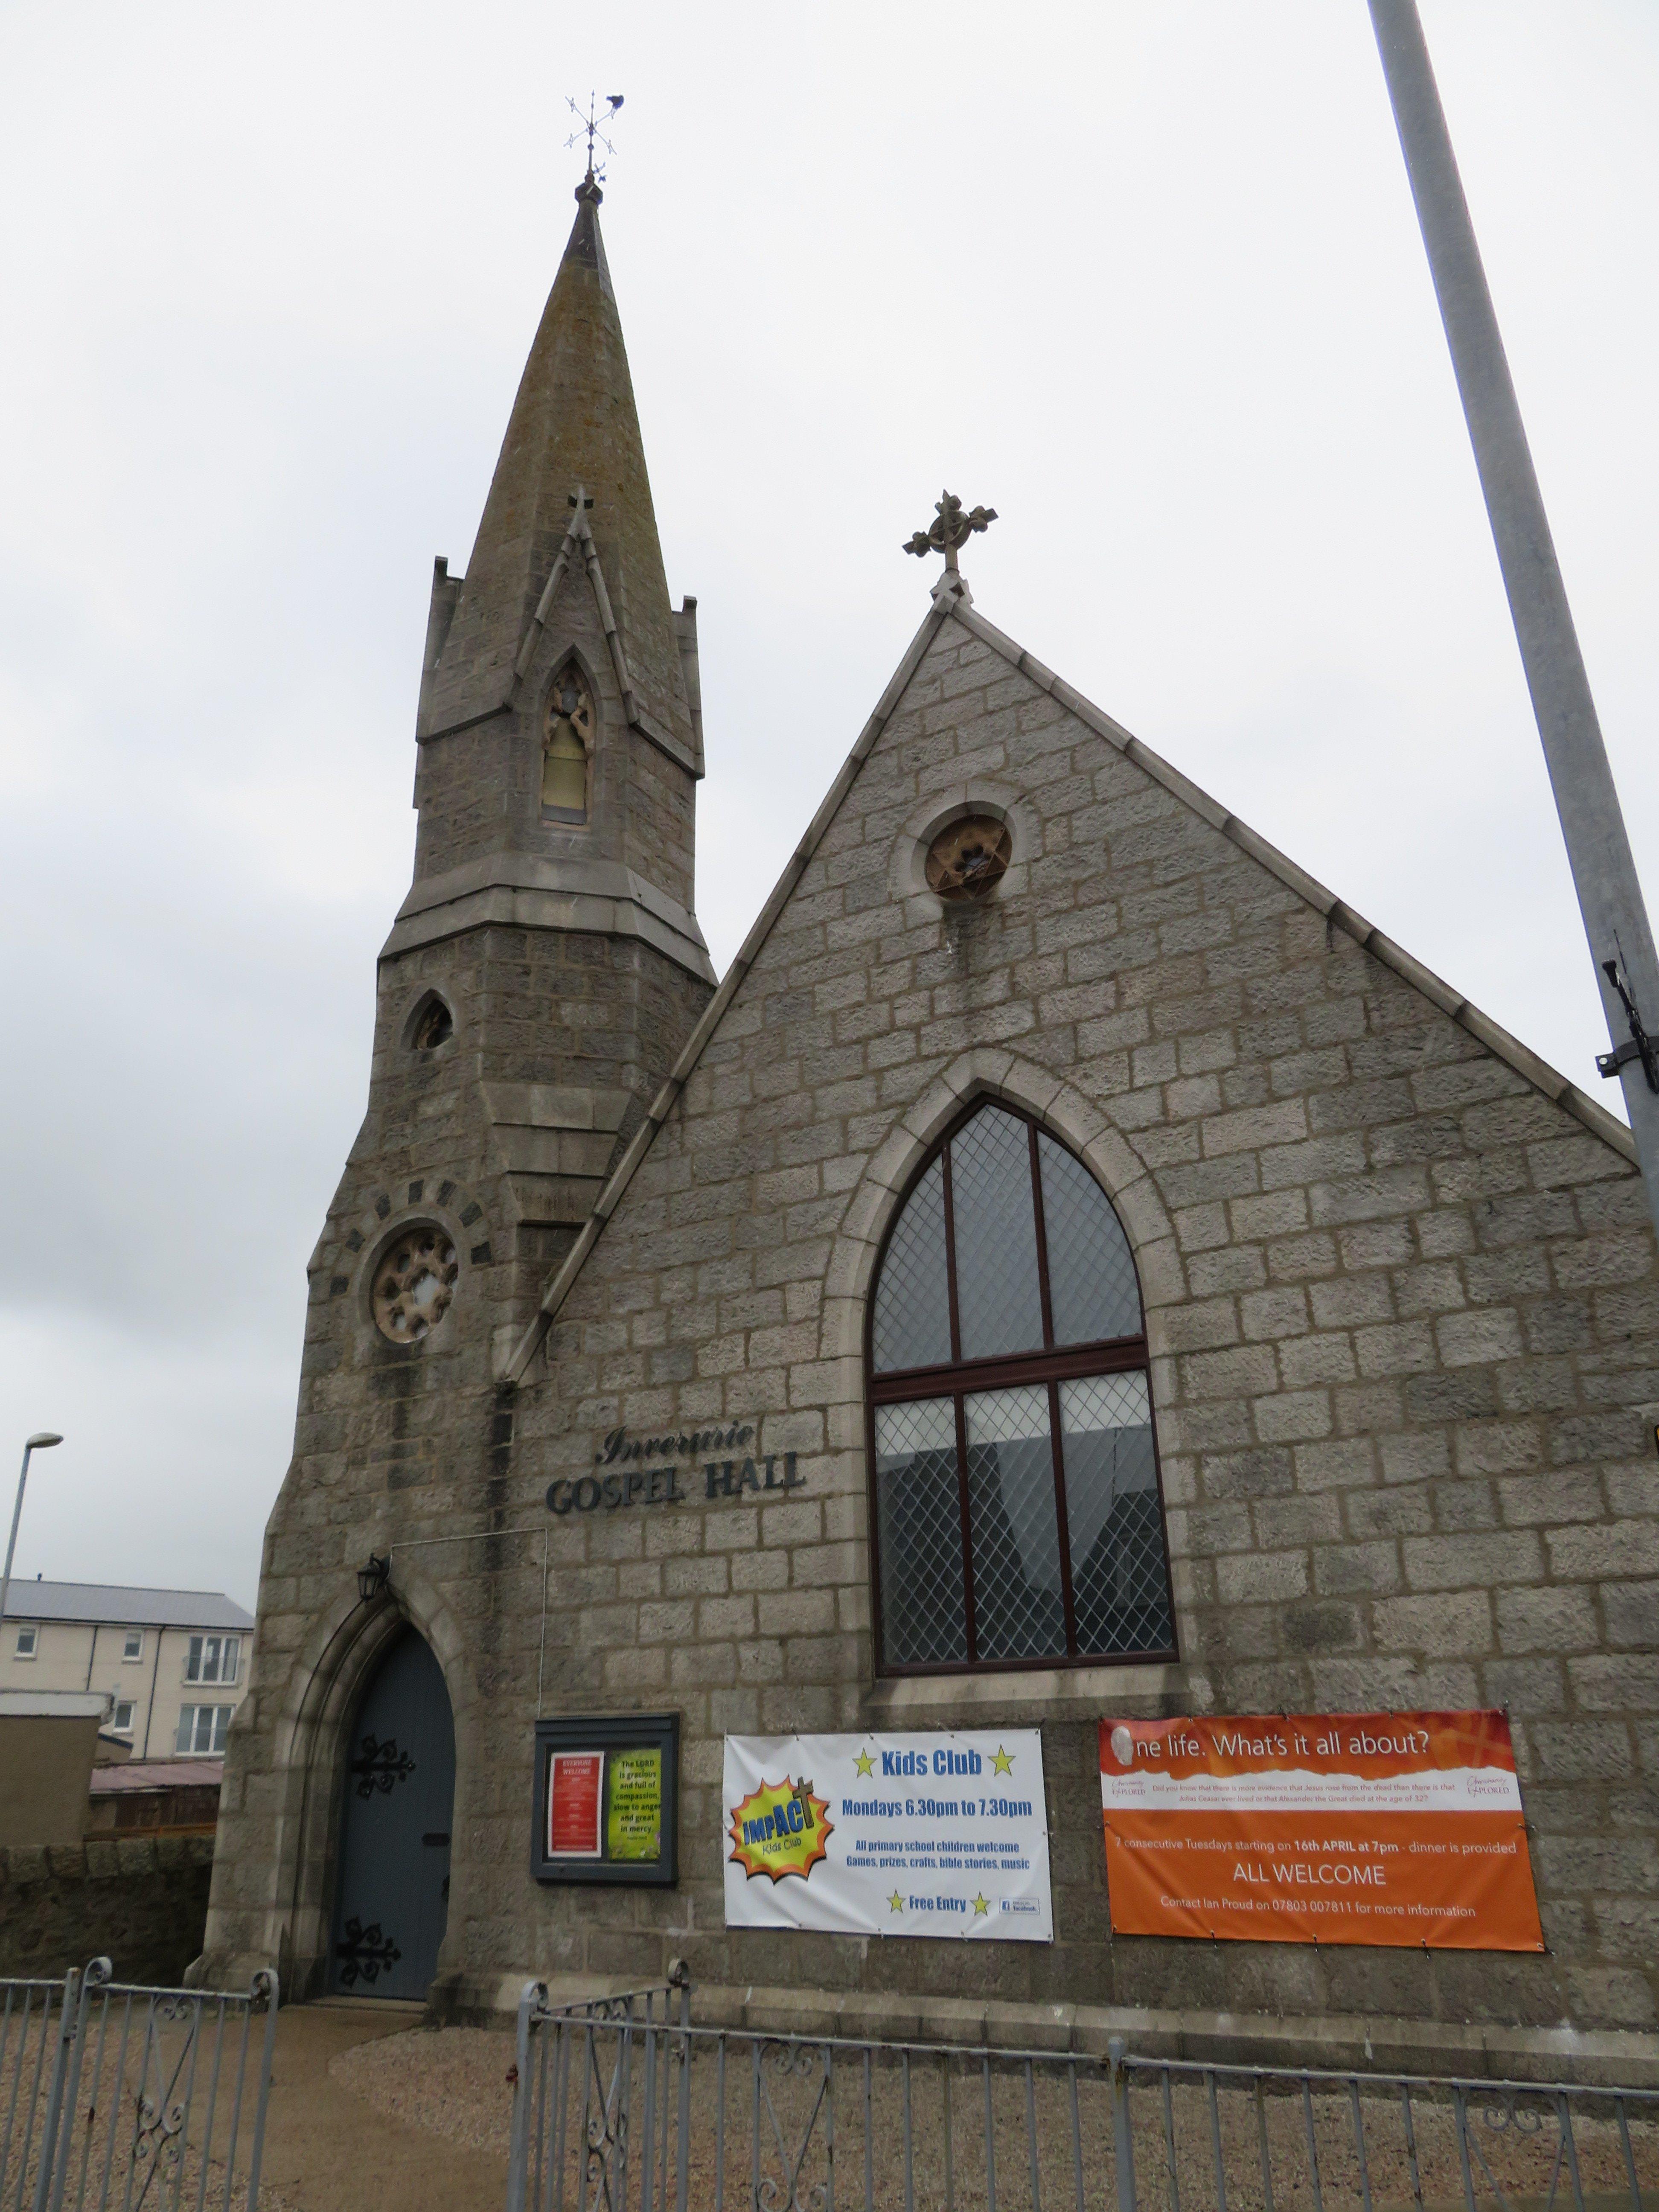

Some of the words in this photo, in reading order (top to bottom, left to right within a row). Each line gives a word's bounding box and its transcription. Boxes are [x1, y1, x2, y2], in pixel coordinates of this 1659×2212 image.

[546, 1467, 685, 1514] GOSPEL
[704, 1452, 806, 1499] HALL
[1168, 1733, 1206, 1757] life.
[1212, 1733, 1287, 1757] What's
[1294, 1732, 1310, 1755] it
[1316, 1731, 1341, 1755] all
[1349, 1730, 1429, 1755] about?
[882, 1750, 928, 1775] Kids
[933, 1749, 981, 1775] Club
[627, 1771, 656, 1780] gracious
[842, 1799, 902, 1818] Mondays
[905, 1799, 958, 1818] 6.30pm
[961, 1800, 976, 1816] to
[978, 1798, 1032, 1818] 7.30pm
[635, 1814, 655, 1823] great
[763, 1842, 781, 1855] Kids
[783, 1837, 801, 1850] Club
[856, 1840, 867, 1851] All
[868, 1840, 903, 1852] primary
[905, 1841, 934, 1852] school
[937, 1841, 975, 1852] children
[977, 1842, 1019, 1853] welcome
[1115, 1837, 1121, 1847] 7
[1124, 1839, 1183, 1849] consecutive
[1185, 1838, 1233, 1852] Tuesdays
[1235, 1839, 1274, 1854] starting
[1278, 1842, 1291, 1850] on
[1295, 1840, 1319, 1851] 16th
[1323, 1840, 1356, 1852] APRIL
[1358, 1842, 1369, 1852] at
[1371, 1840, 1399, 1855] 7pm
[1409, 1841, 1446, 1854] dinner
[1450, 1842, 1459, 1854] is
[1462, 1842, 1516, 1856] provided
[846, 1856, 878, 1868] Games,
[880, 1856, 908, 1869] prizes,
[910, 1857, 938, 1869] crafts,
[940, 1857, 962, 1869] bible
[964, 1858, 999, 1870] stories,
[1001, 1858, 1030, 1870] music
[1233, 1863, 1270, 1883] ALL
[1272, 1863, 1386, 1885] WELCOME
[909, 1895, 934, 1910] Free
[937, 1896, 966, 1913] Entry
[1161, 1895, 1201, 1909] Contact
[1203, 1897, 1219, 1909] Ian
[1222, 1898, 1252, 1910] Proud
[1256, 1902, 1269, 1910] on
[1272, 1900, 1307, 1912] 07803
[1310, 1901, 1351, 1913] 007811
[1355, 1901, 1373, 1914] for
[1374, 1904, 1405, 1915] more
[1408, 1904, 1476, 1917] information
